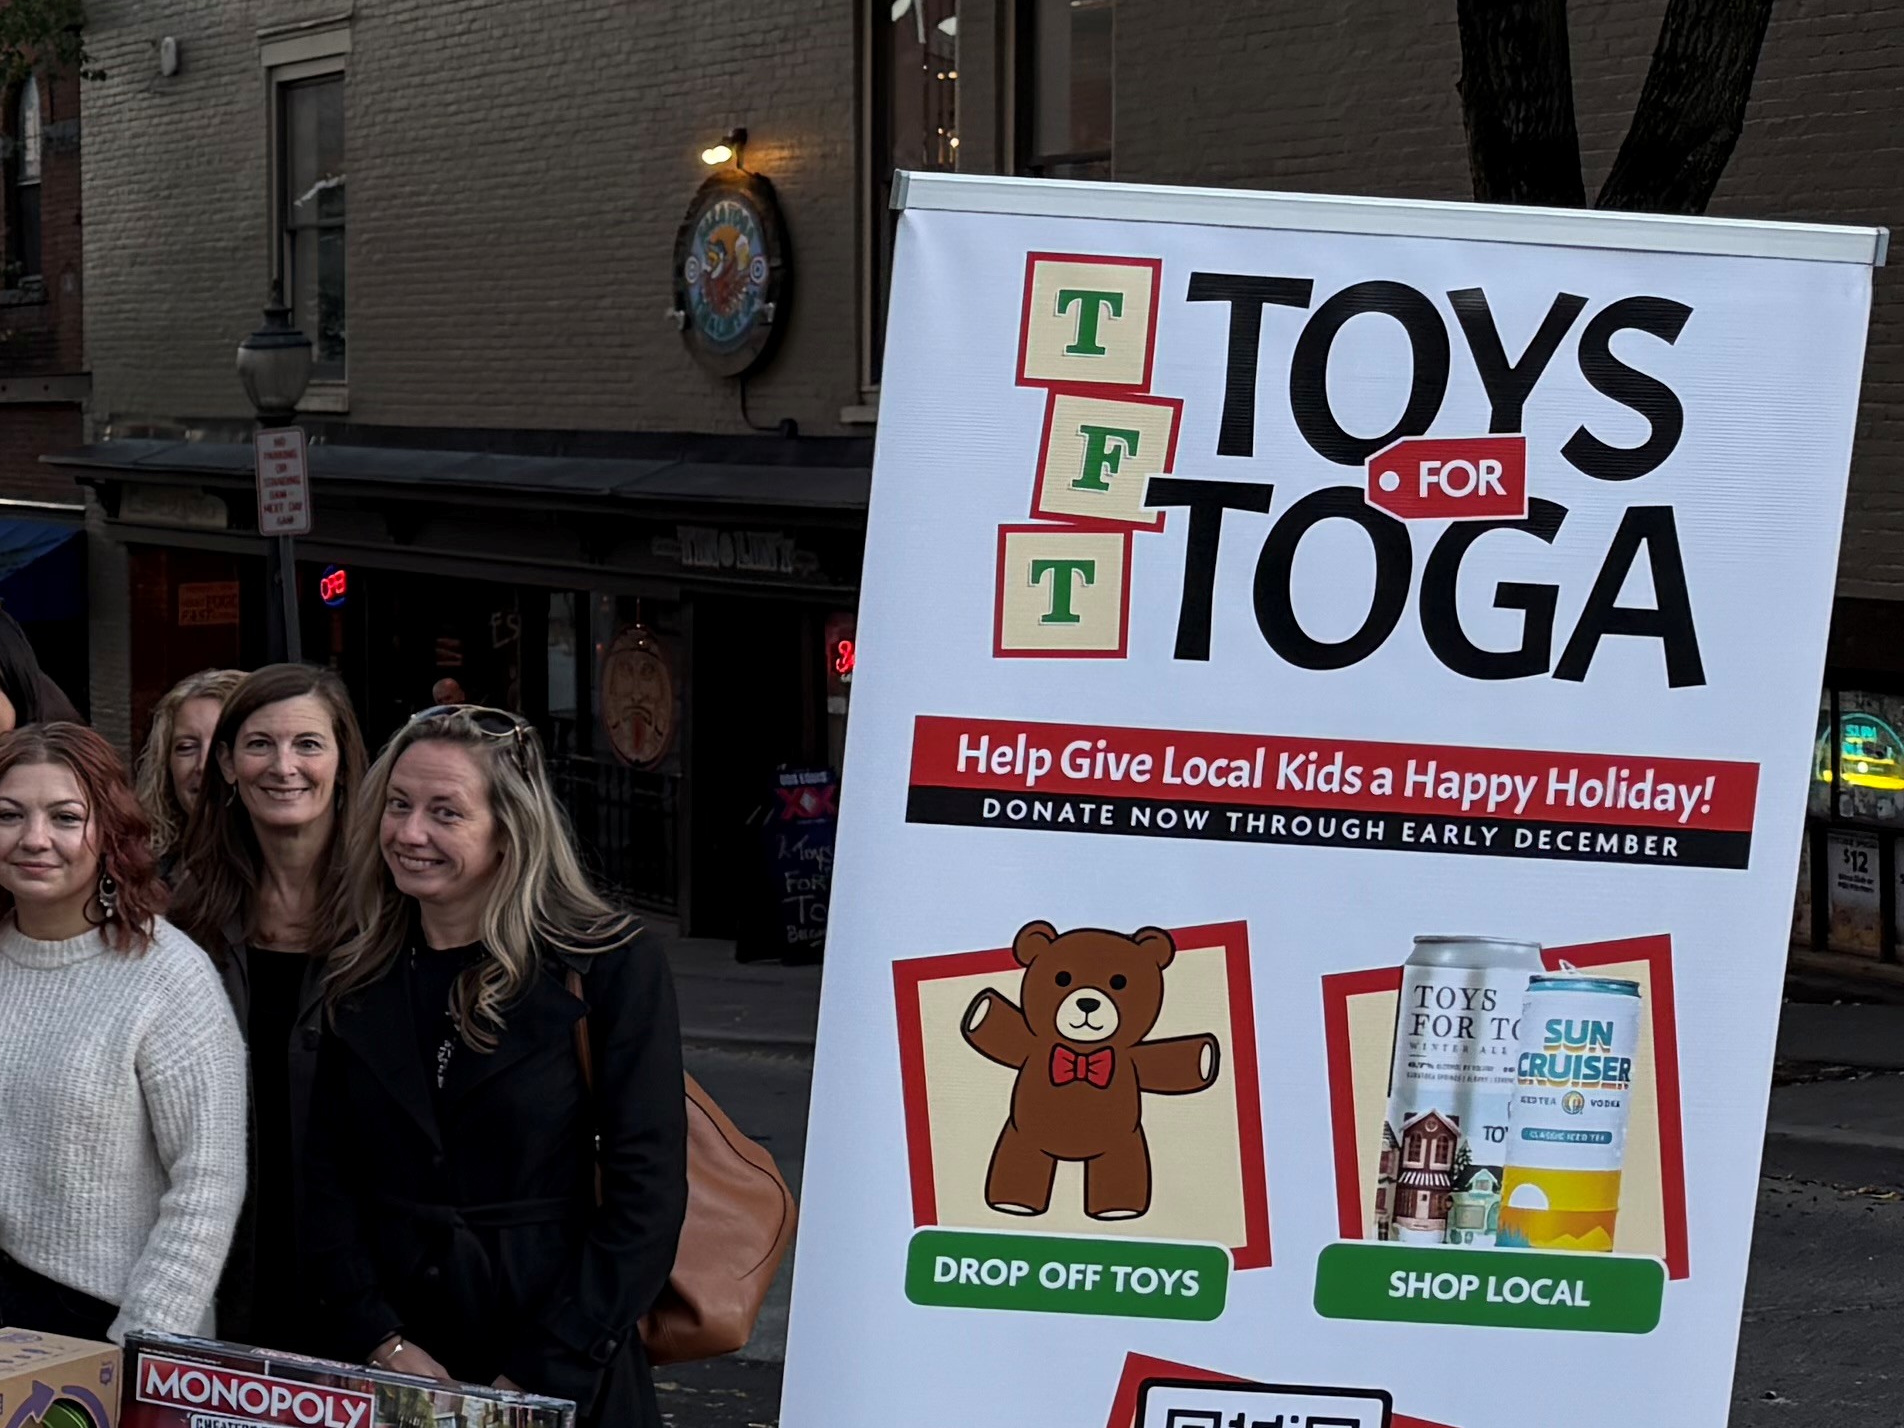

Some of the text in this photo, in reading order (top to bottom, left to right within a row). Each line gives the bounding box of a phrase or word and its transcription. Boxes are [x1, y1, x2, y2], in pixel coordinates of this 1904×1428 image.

[1186, 272, 1693, 488] TOYS
[1419, 459, 1507, 498] FOR
[1144, 468, 1706, 688] TOGA
[957, 733, 1715, 823] Help Give Local Kids a Happy Holiday!
[983, 798, 1677, 857] DONATE NOW THROUGH EARLY DECEMBER
[1413, 984, 1497, 1012] TOYS
[1408, 1012, 1476, 1040] FOR
[1544, 1019, 1614, 1051] SUN
[1517, 1052, 1631, 1085] CRUISER
[934, 1256, 1199, 1296] DROP OFF TOYS
[1389, 1271, 1590, 1307] SHOP LOCAL
